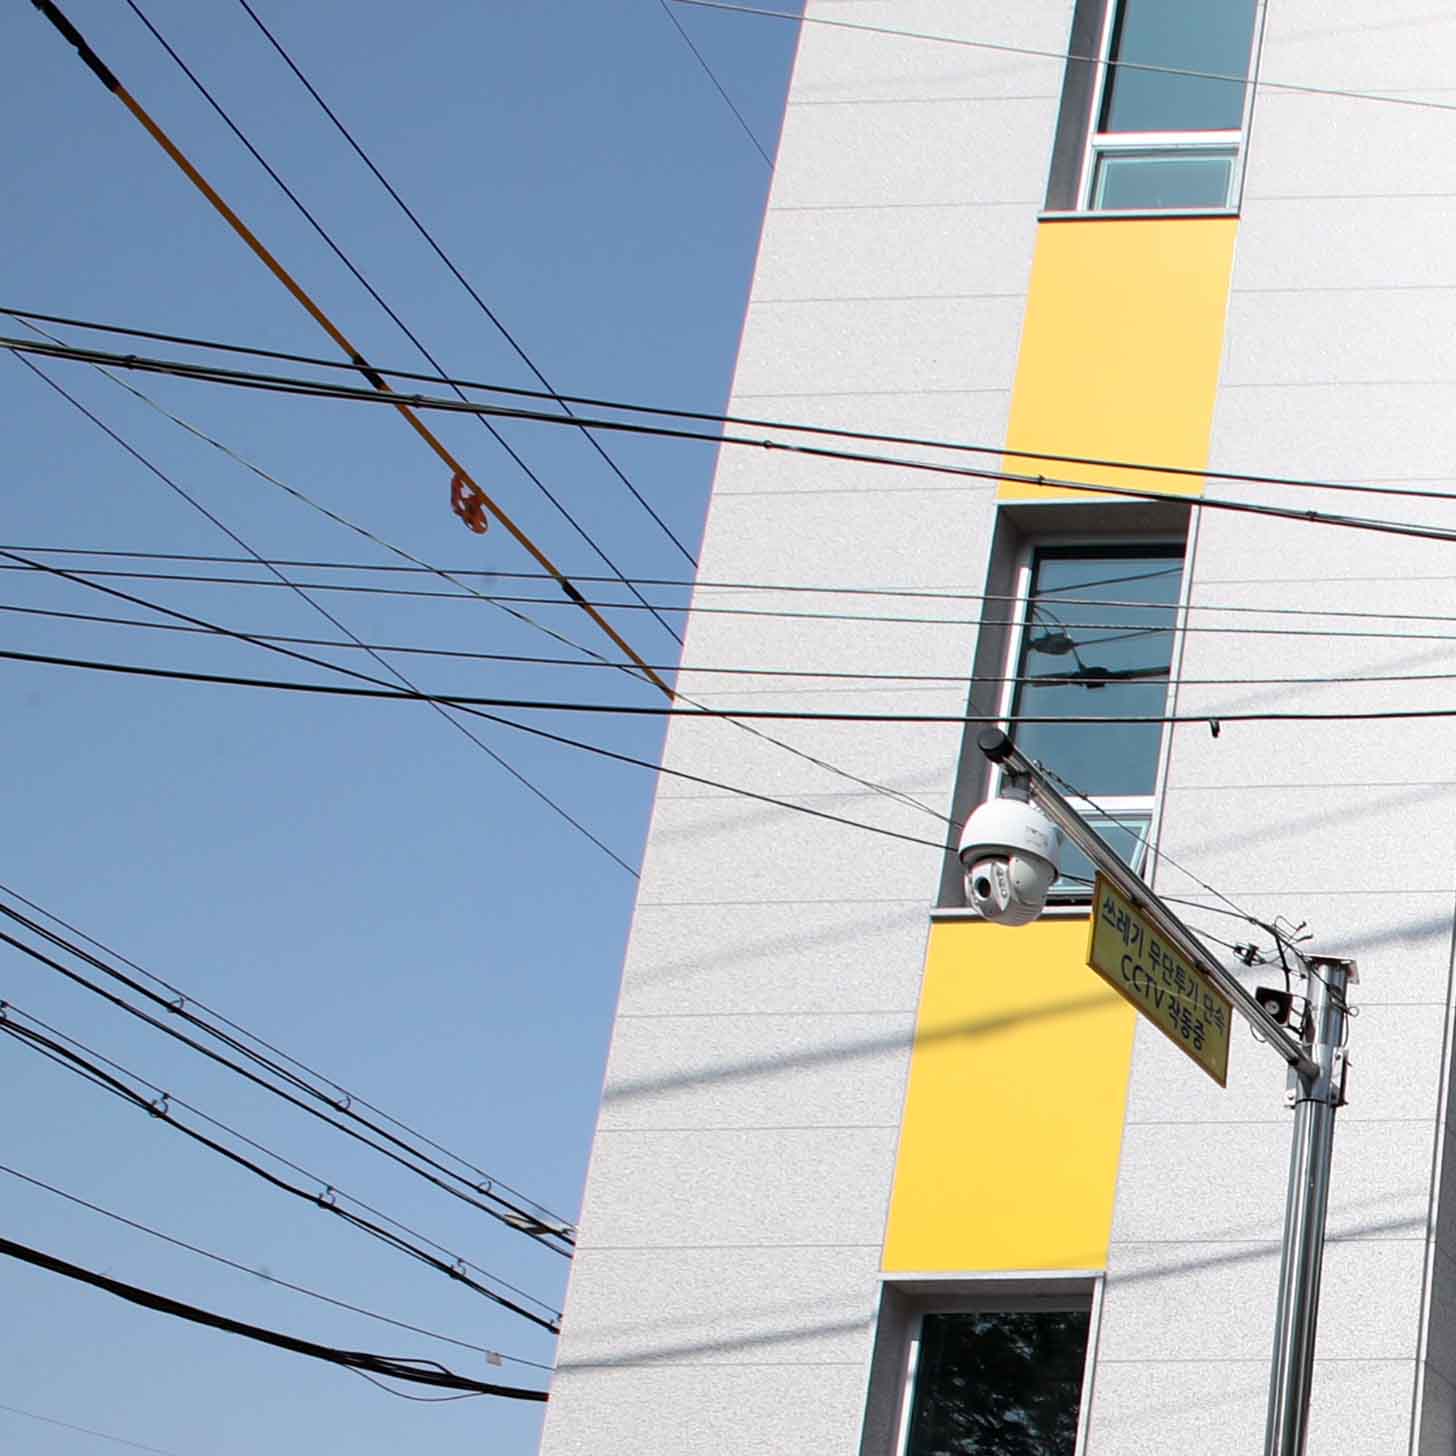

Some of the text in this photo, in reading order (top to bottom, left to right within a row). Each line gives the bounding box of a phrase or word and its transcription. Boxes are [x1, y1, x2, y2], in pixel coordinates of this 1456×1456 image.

[1102, 896, 1145, 959] 쓰레기
[1148, 939, 1200, 1009] 무단투기
[1121, 954, 1206, 1051] CCTV 작동중
